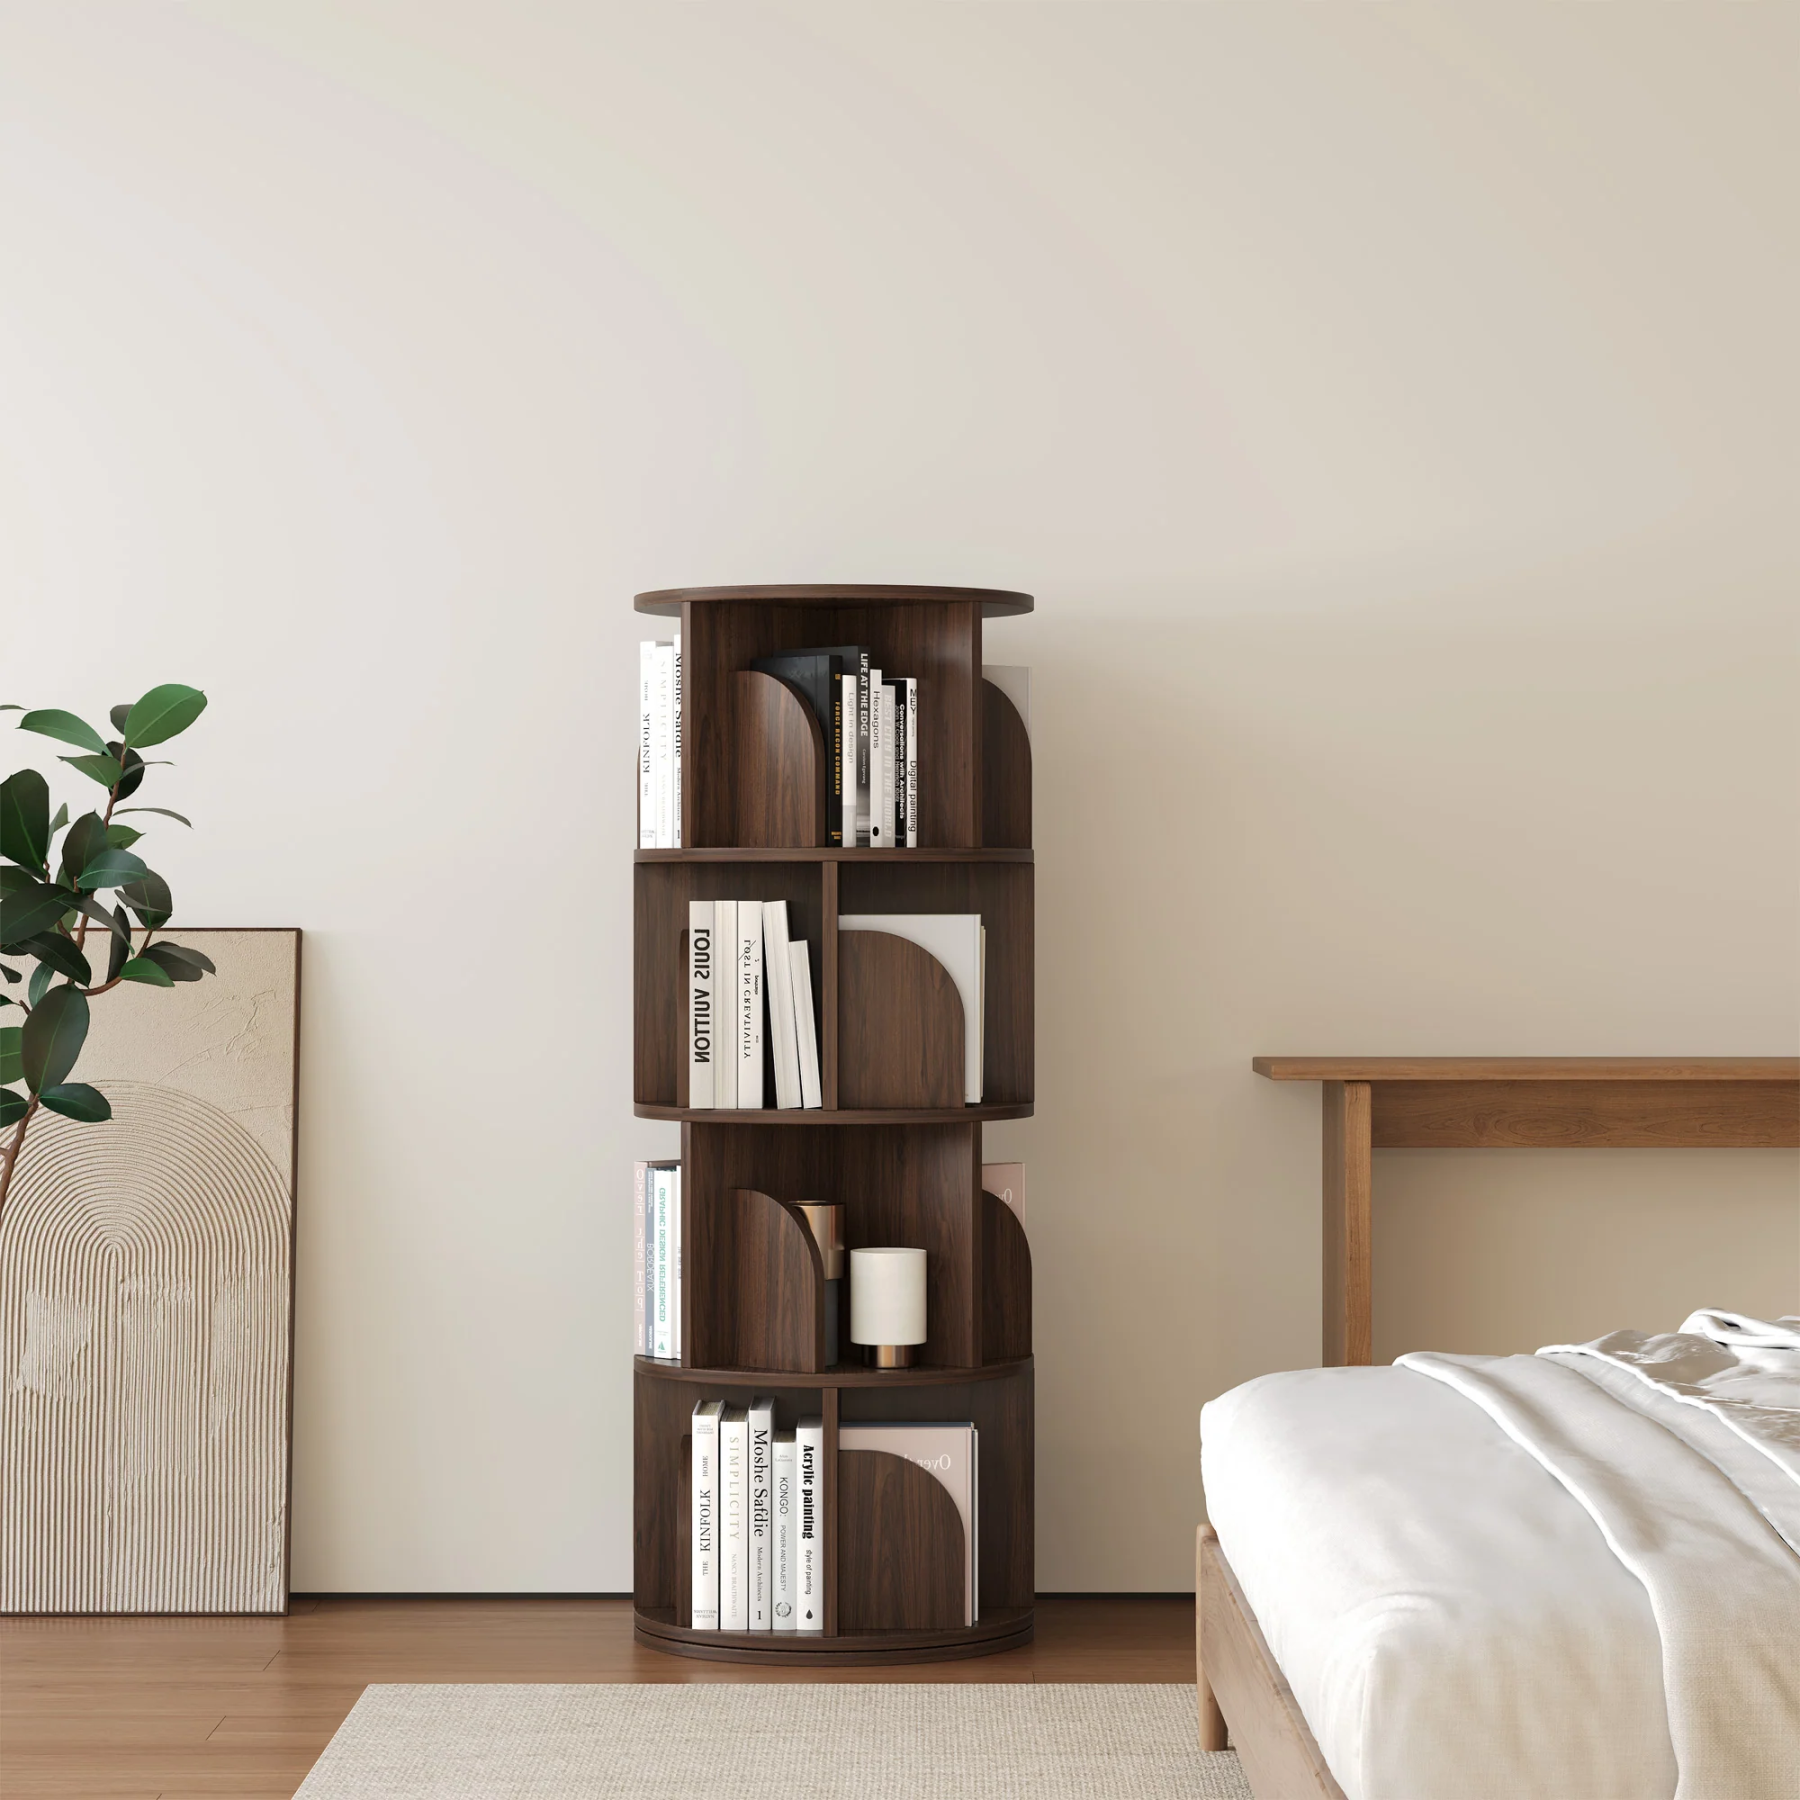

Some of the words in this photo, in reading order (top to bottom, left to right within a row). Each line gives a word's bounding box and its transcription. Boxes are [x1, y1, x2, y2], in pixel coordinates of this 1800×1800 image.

[860, 675, 868, 688] AT
[848, 720, 854, 728] in
[884, 694, 892, 723] BEST
[884, 725, 892, 752] CITY
[884, 772, 892, 794] THE
[908, 761, 916, 791] Digital
[884, 798, 892, 837] WORLD
[908, 795, 916, 832] painting
[753, 1429, 768, 1483] Moshe
[803, 1445, 815, 1486] Acrylic
[729, 1437, 739, 1540] SIMPLICITY
[780, 1477, 789, 1517] KONGO:
[700, 1490, 711, 1552] KINFOLK
[753, 1488, 768, 1537] Safdie
[802, 1489, 815, 1539] painting
[805, 1549, 813, 1563] style
[805, 1572, 813, 1595] painting
[757, 1611, 762, 1620] 1
